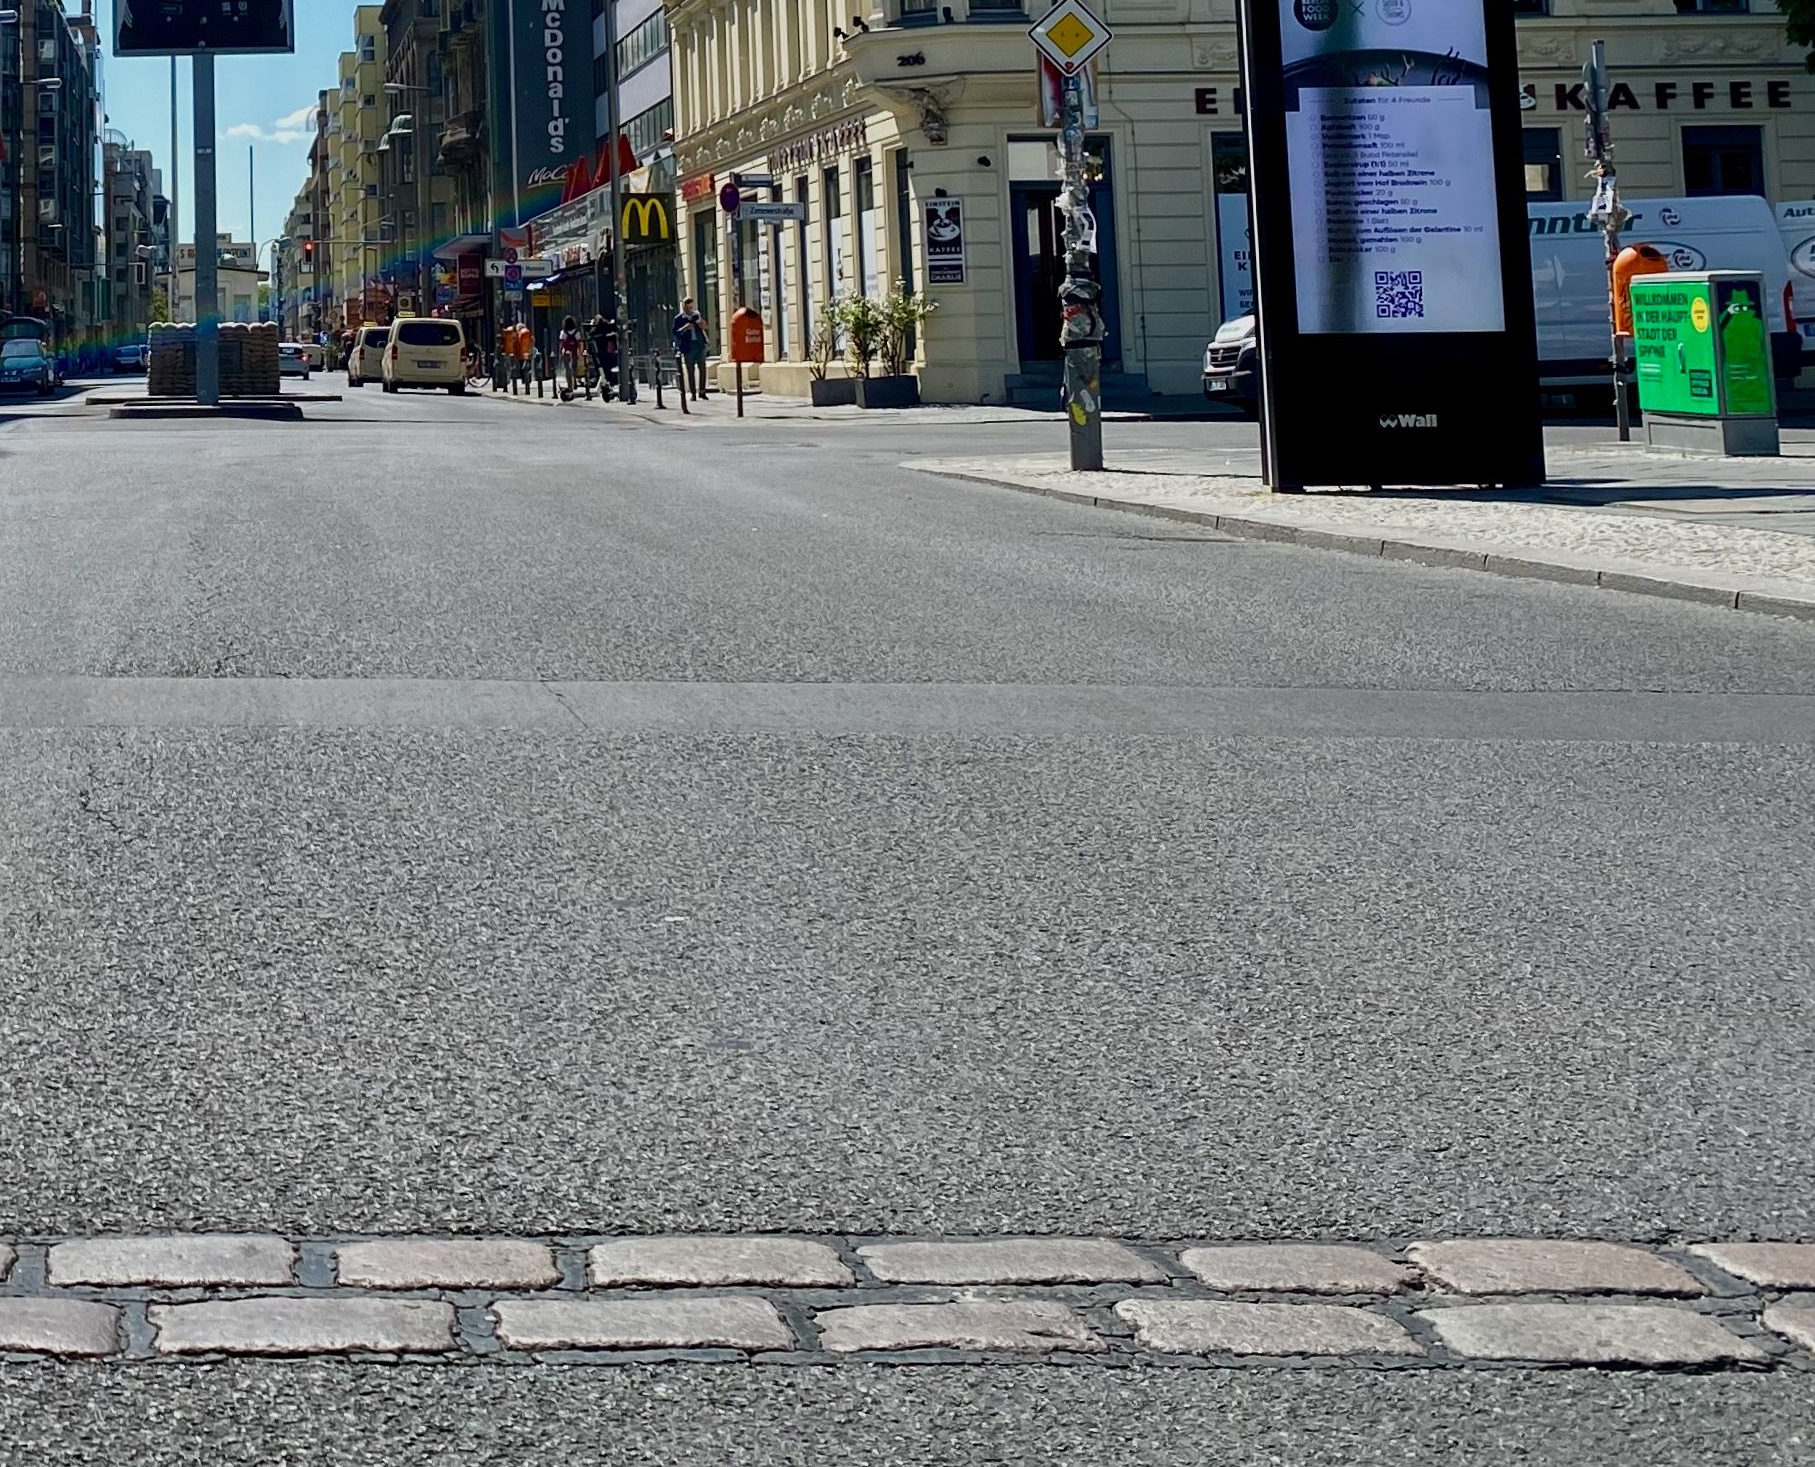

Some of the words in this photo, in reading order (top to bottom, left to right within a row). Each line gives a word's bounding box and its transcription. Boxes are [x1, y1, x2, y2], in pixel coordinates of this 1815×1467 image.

[1302, 5, 1330, 13] FOOD
[1303, 13, 1330, 21] WEEK
[896, 52, 926, 67] 206
[1555, 80, 1792, 110] KAFFEE
[528, 164, 576, 184] McCa
[1635, 293, 1688, 305] WILLKOMMEN
[1636, 311, 1645, 323] IN
[1646, 311, 1660, 323] DER
[1637, 328, 1661, 341] STADT
[1662, 328, 1677, 341] DER
[1638, 345, 1666, 358] SPIONE
[1398, 413, 1437, 427] Wall
